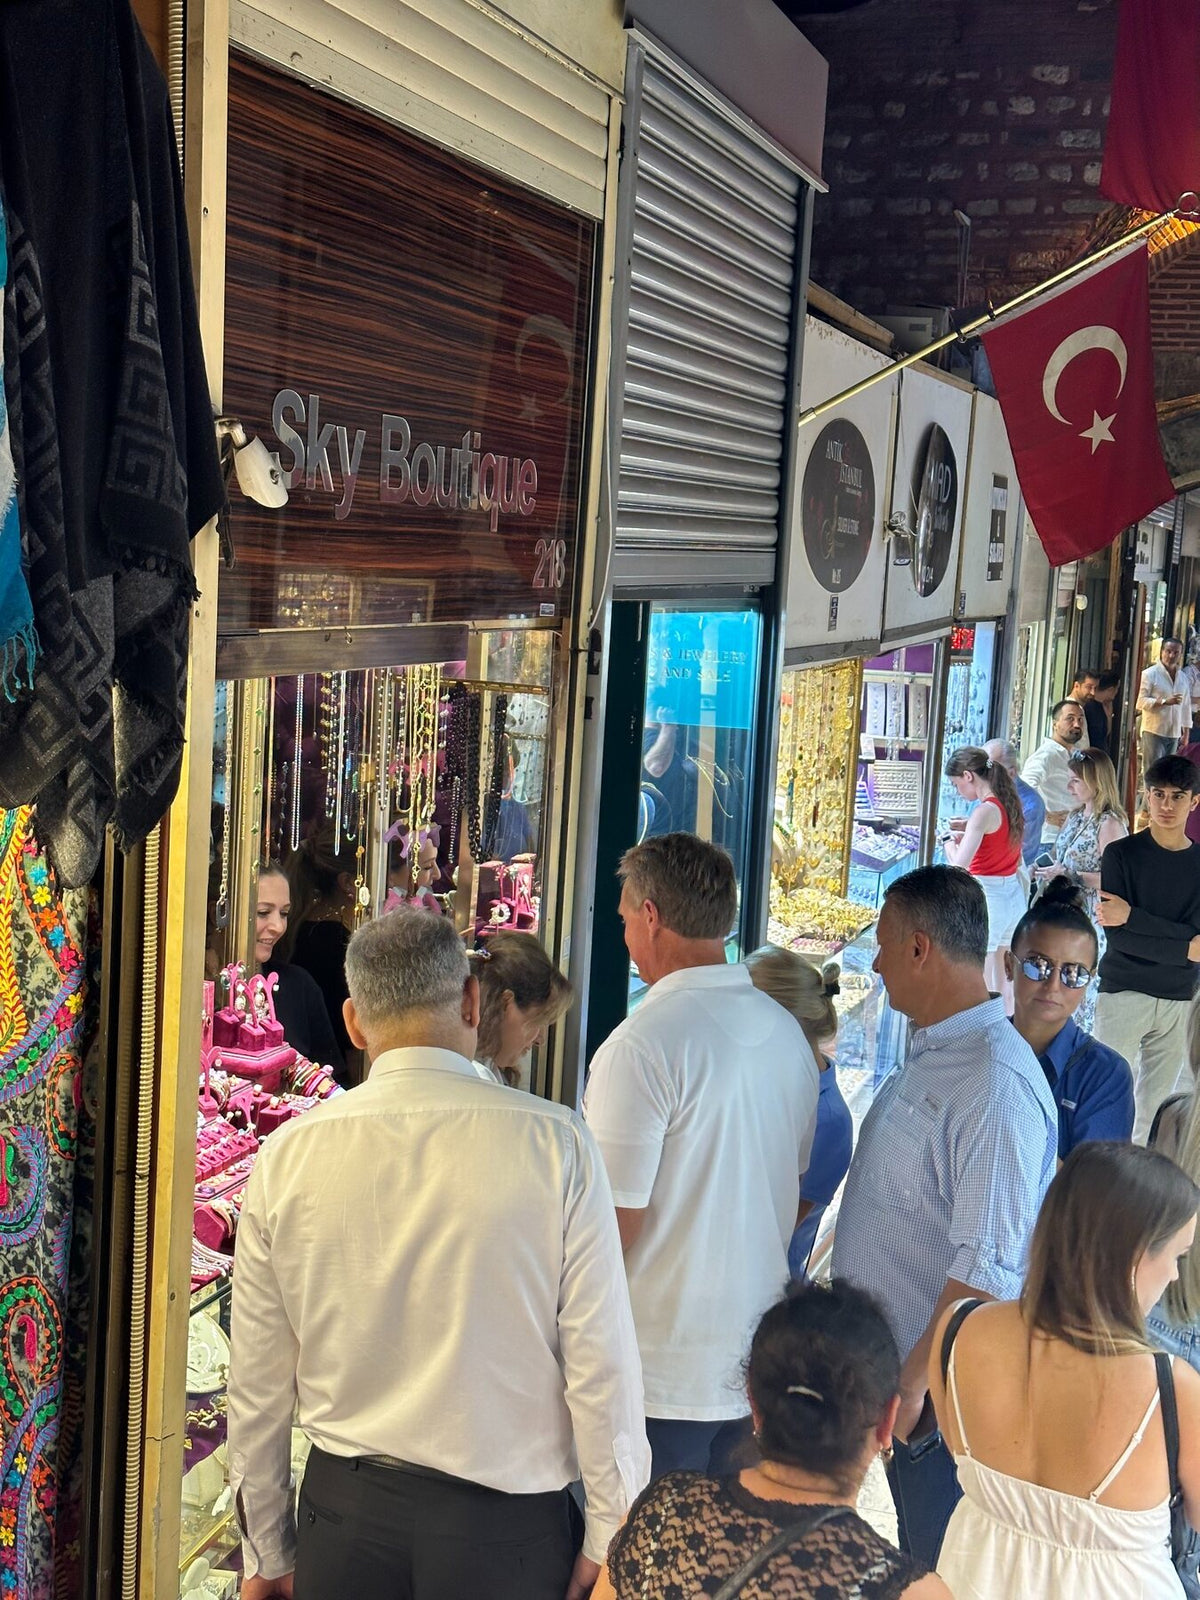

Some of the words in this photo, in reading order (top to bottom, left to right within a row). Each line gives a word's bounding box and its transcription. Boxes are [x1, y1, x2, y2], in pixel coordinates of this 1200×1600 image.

[270, 388, 366, 520] Sky
[380, 413, 538, 532] Boutique
[532, 538, 567, 588] 218
[664, 667, 691, 680] AND
[696, 669, 732, 683] SALE
